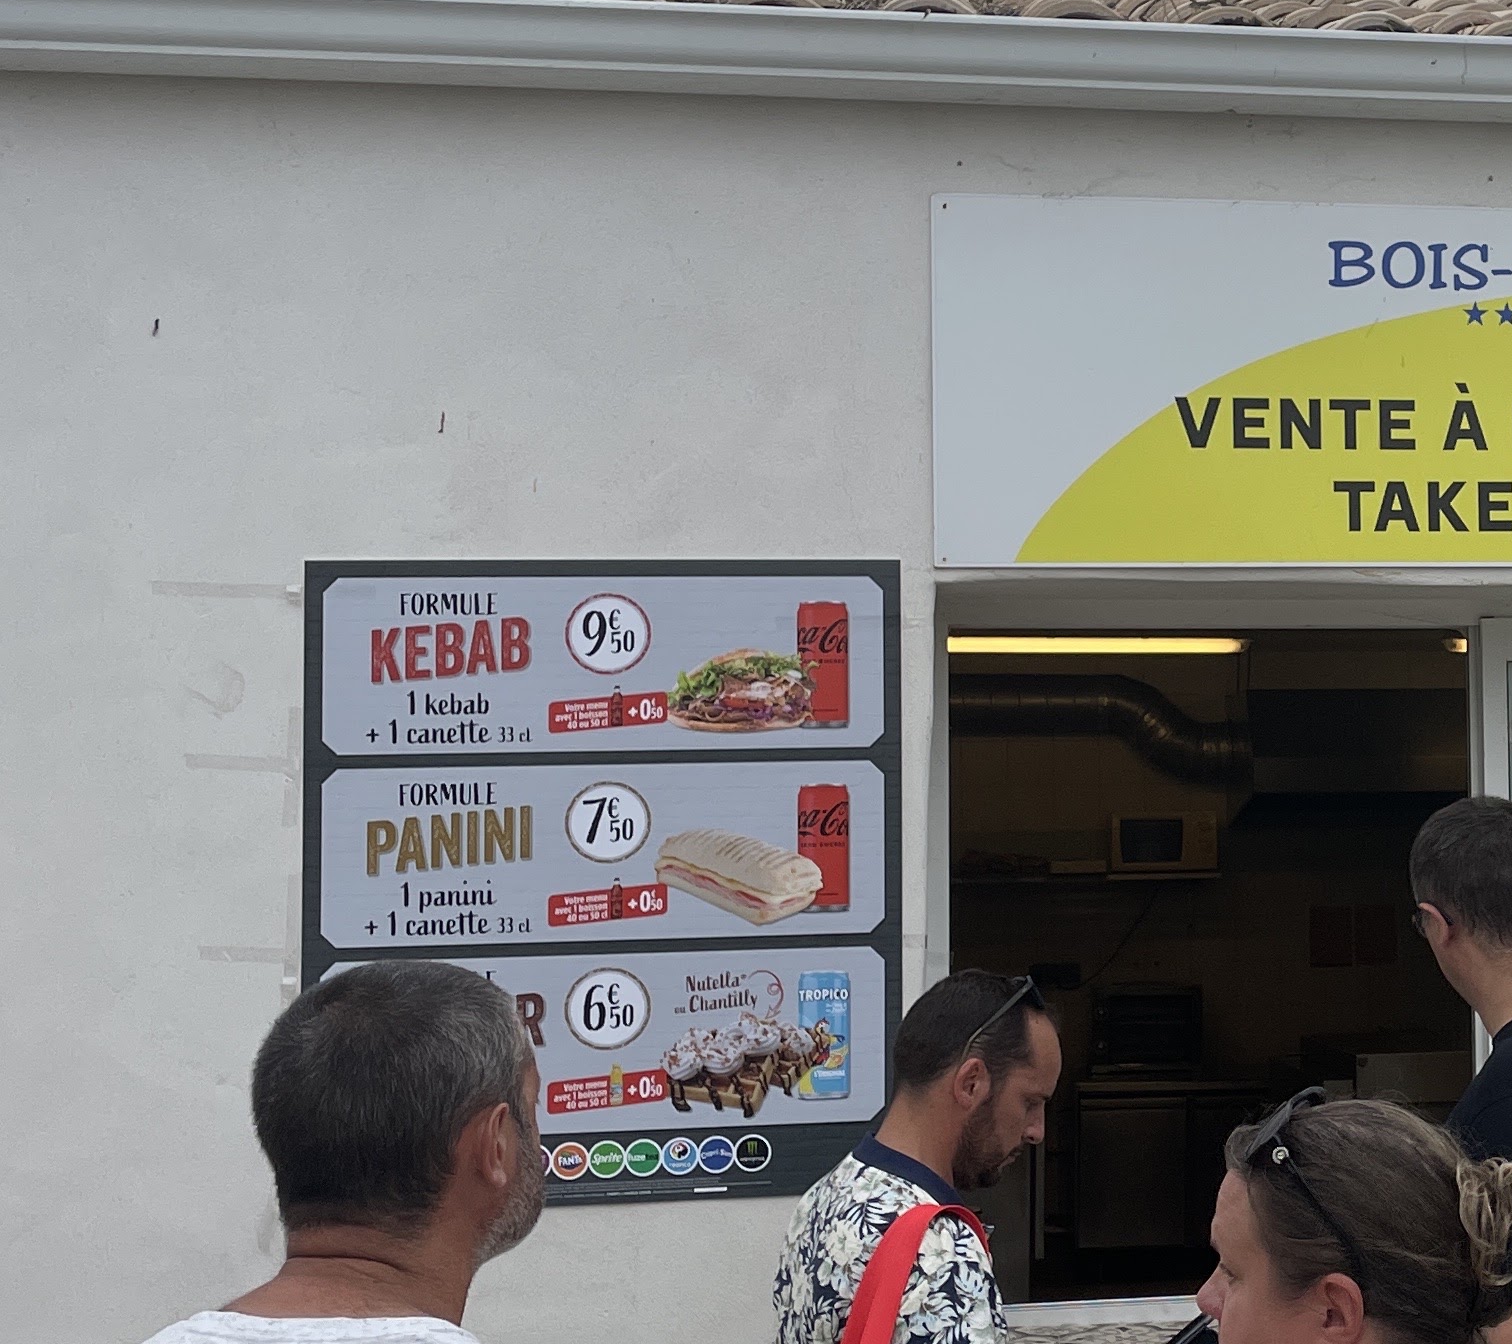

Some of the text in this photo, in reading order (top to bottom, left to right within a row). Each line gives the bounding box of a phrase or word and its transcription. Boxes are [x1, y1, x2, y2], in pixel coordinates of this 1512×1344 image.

[1175, 396, 1418, 451] VENTE
[1443, 383, 1490, 452] À
[400, 593, 498, 615] FORMULE
[371, 617, 532, 684] KEBAB
[407, 690, 489, 715] 1 kebab
[389, 719, 397, 744] 1
[407, 720, 492, 744] canette
[498, 726, 514, 742] 33
[519, 727, 533, 742] cl
[399, 782, 497, 806] FORMULE
[367, 805, 533, 877] PANINI
[400, 880, 497, 913] 1 panini
[387, 911, 396, 936] 1
[406, 911, 491, 936] canette
[497, 917, 513, 933] 33
[519, 918, 532, 933] cl
[689, 990, 758, 1013] Chantilly
[799, 989, 848, 1002] TROPICO
[592, 1152, 622, 1165] Sprite
